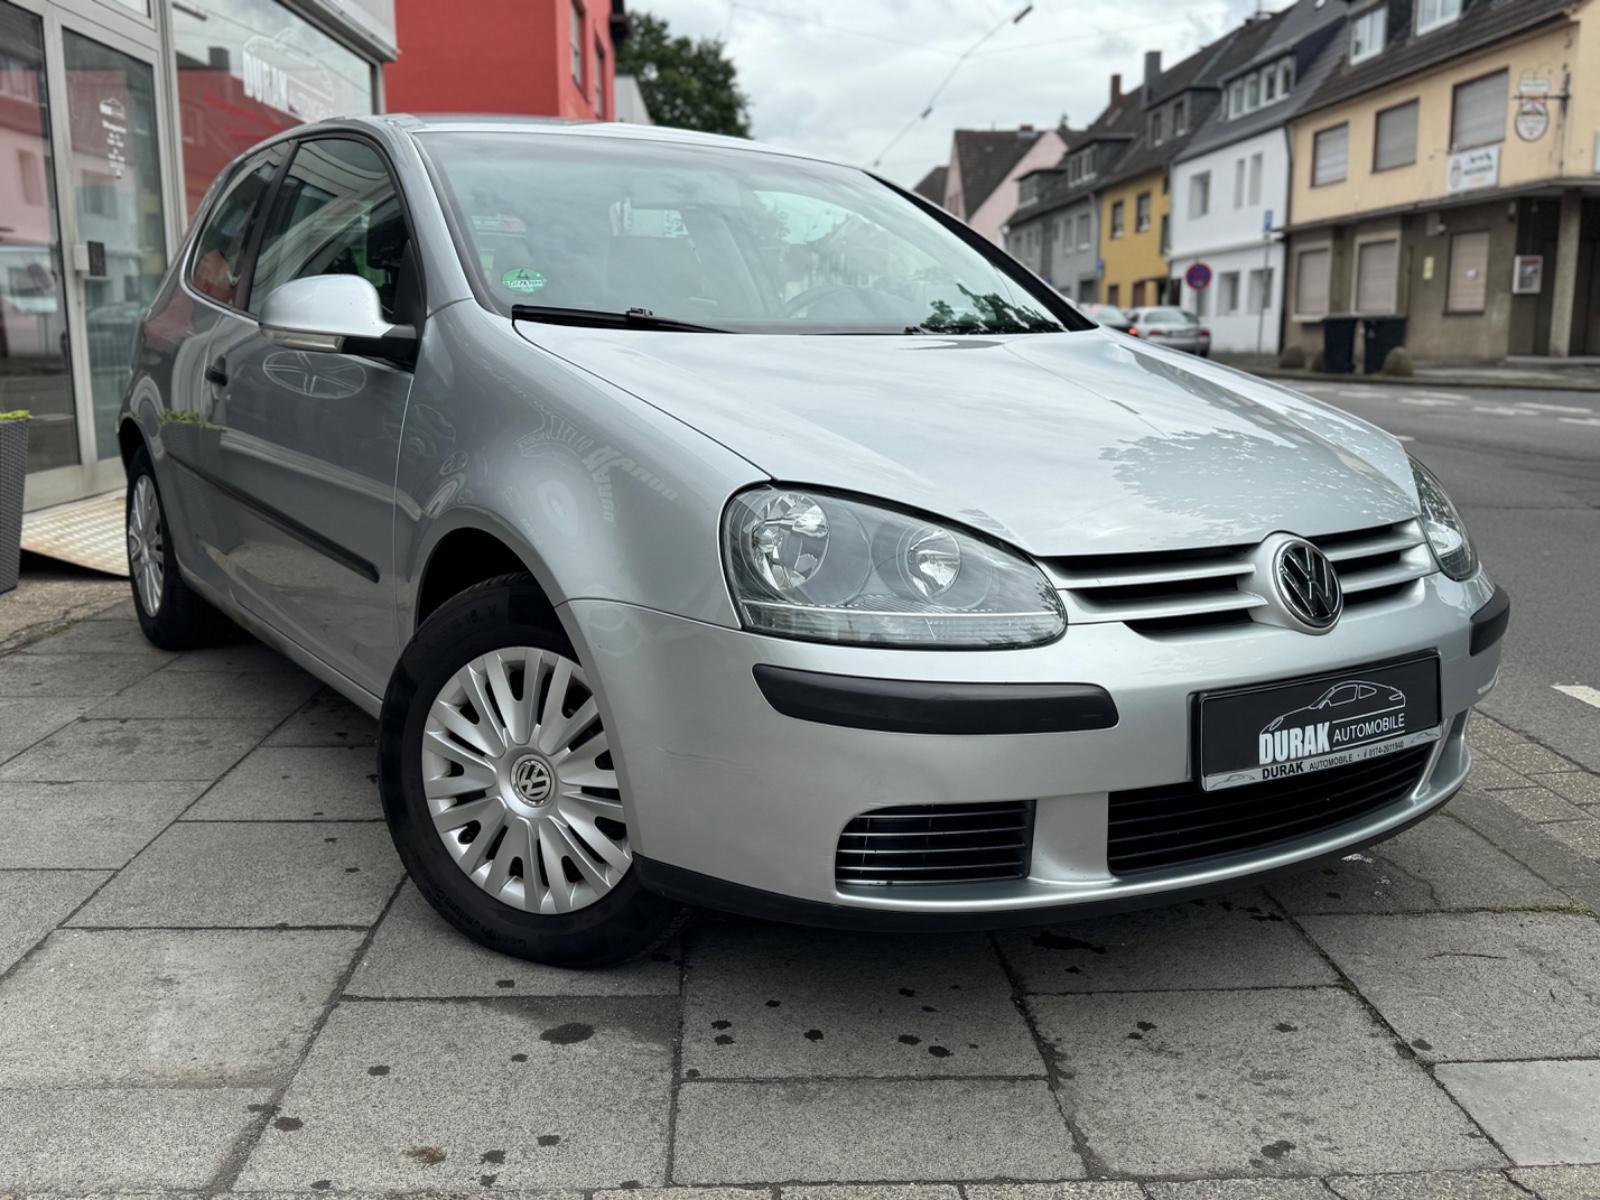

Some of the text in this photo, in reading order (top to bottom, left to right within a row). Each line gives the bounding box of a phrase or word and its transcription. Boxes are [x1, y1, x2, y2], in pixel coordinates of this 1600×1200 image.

[1258, 713, 1405, 765] DURAK AUTOMOBILE
[1262, 761, 1304, 780] DURAK
[1309, 753, 1353, 770] AUTOMOBILE
